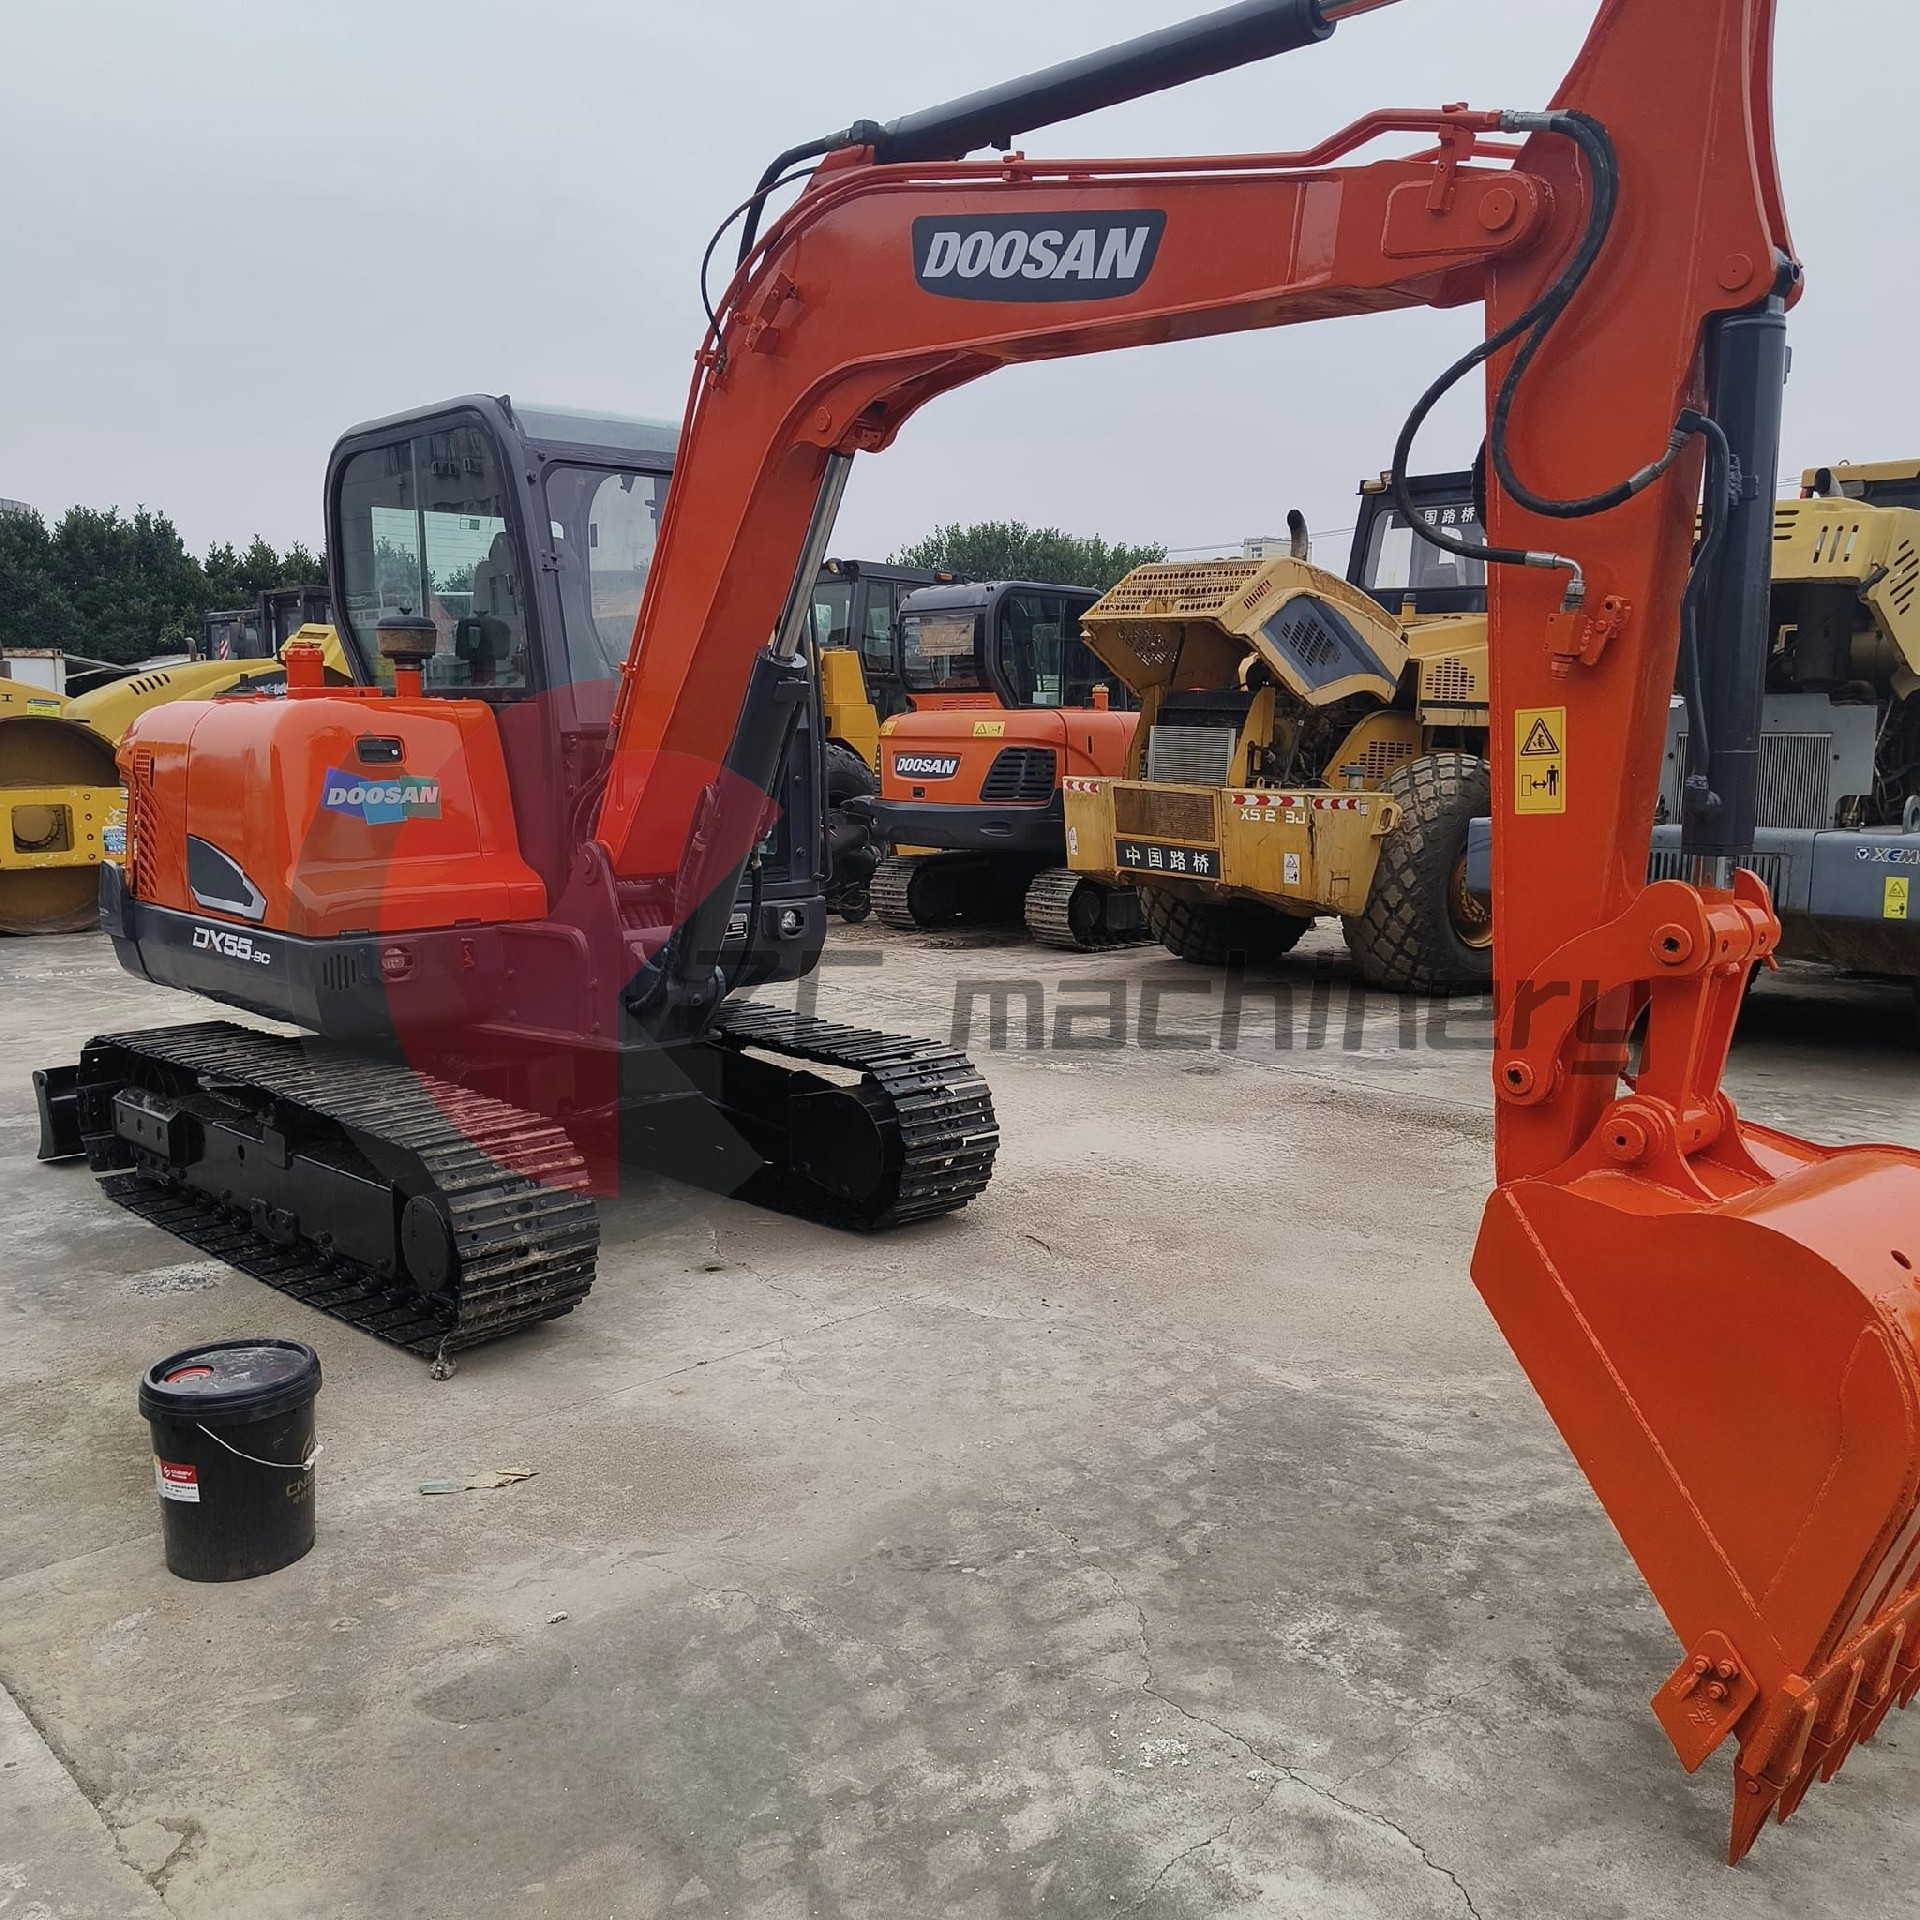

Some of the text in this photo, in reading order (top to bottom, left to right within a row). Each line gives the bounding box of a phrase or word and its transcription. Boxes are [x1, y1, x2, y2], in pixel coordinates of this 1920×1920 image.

[922, 226, 1150, 280] DOOSAN
[896, 757, 957, 774] DOOSAN
[326, 786, 439, 806] DOOSAN
[1126, 845, 1210, 874] 中国路桥
[1871, 847, 1920, 864] XCM
